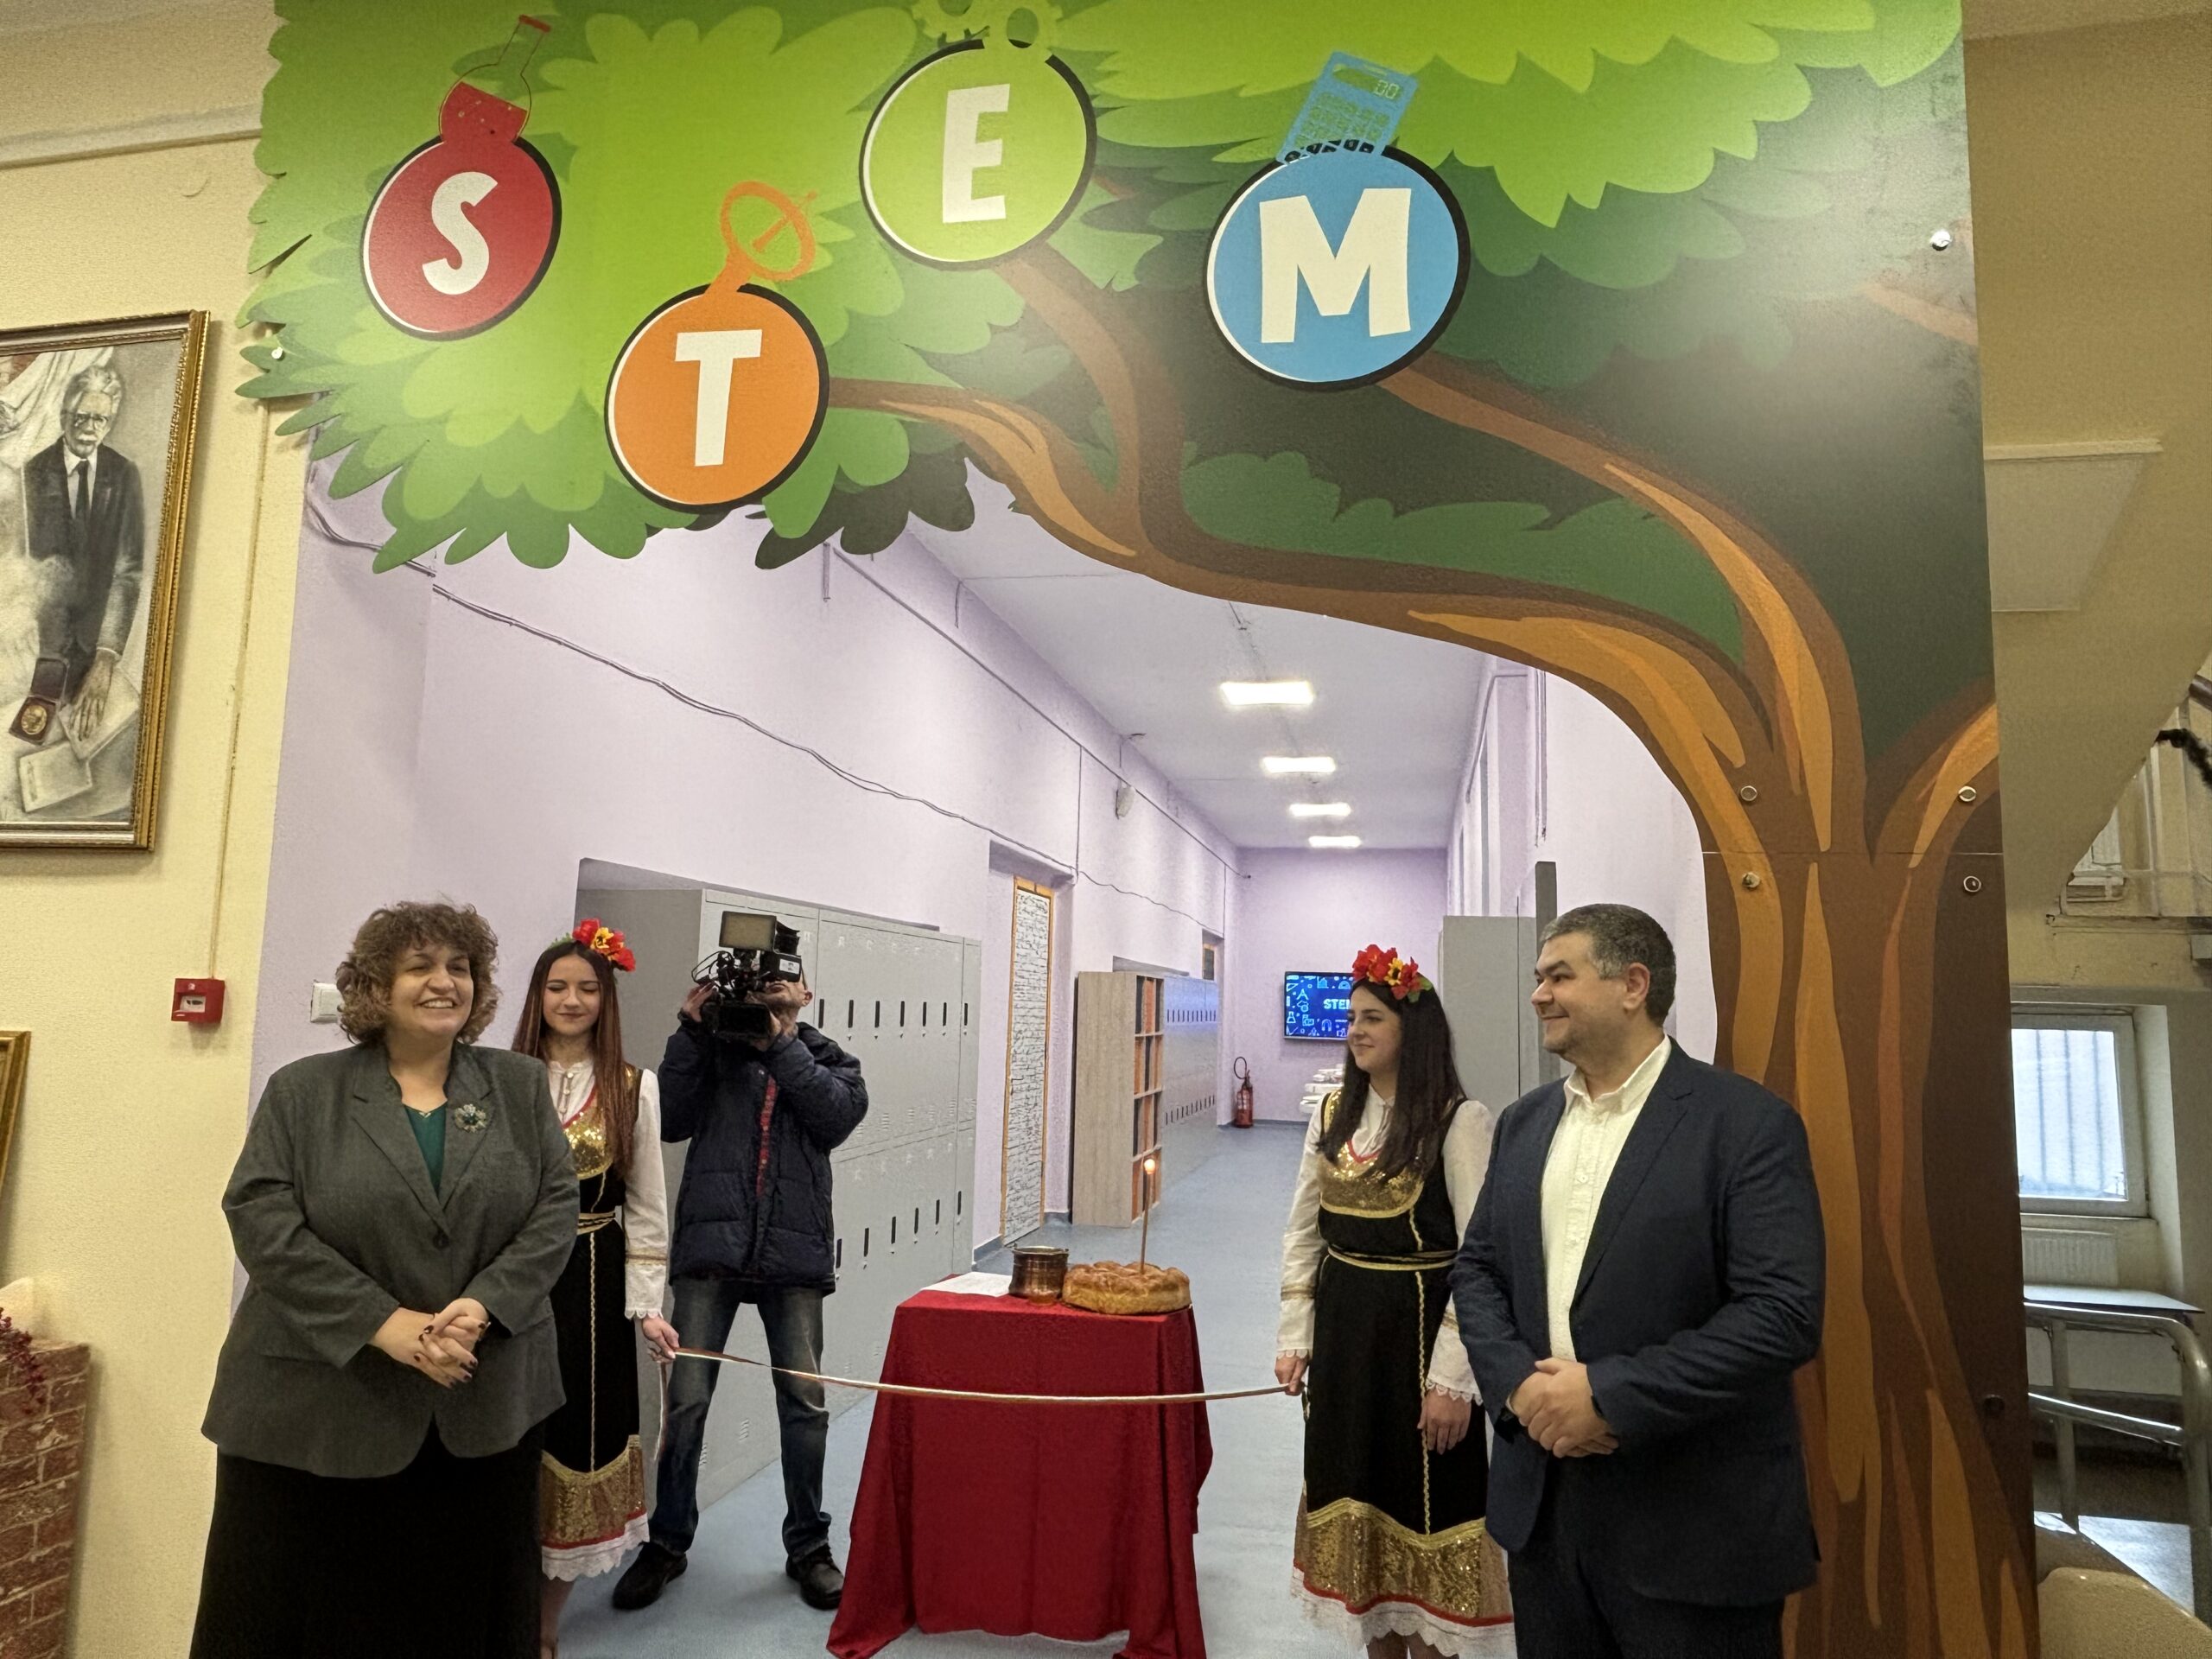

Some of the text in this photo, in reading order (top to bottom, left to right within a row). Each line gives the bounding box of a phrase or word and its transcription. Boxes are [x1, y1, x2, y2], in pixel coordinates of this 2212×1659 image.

[422, 83, 1412, 467] S T E M
